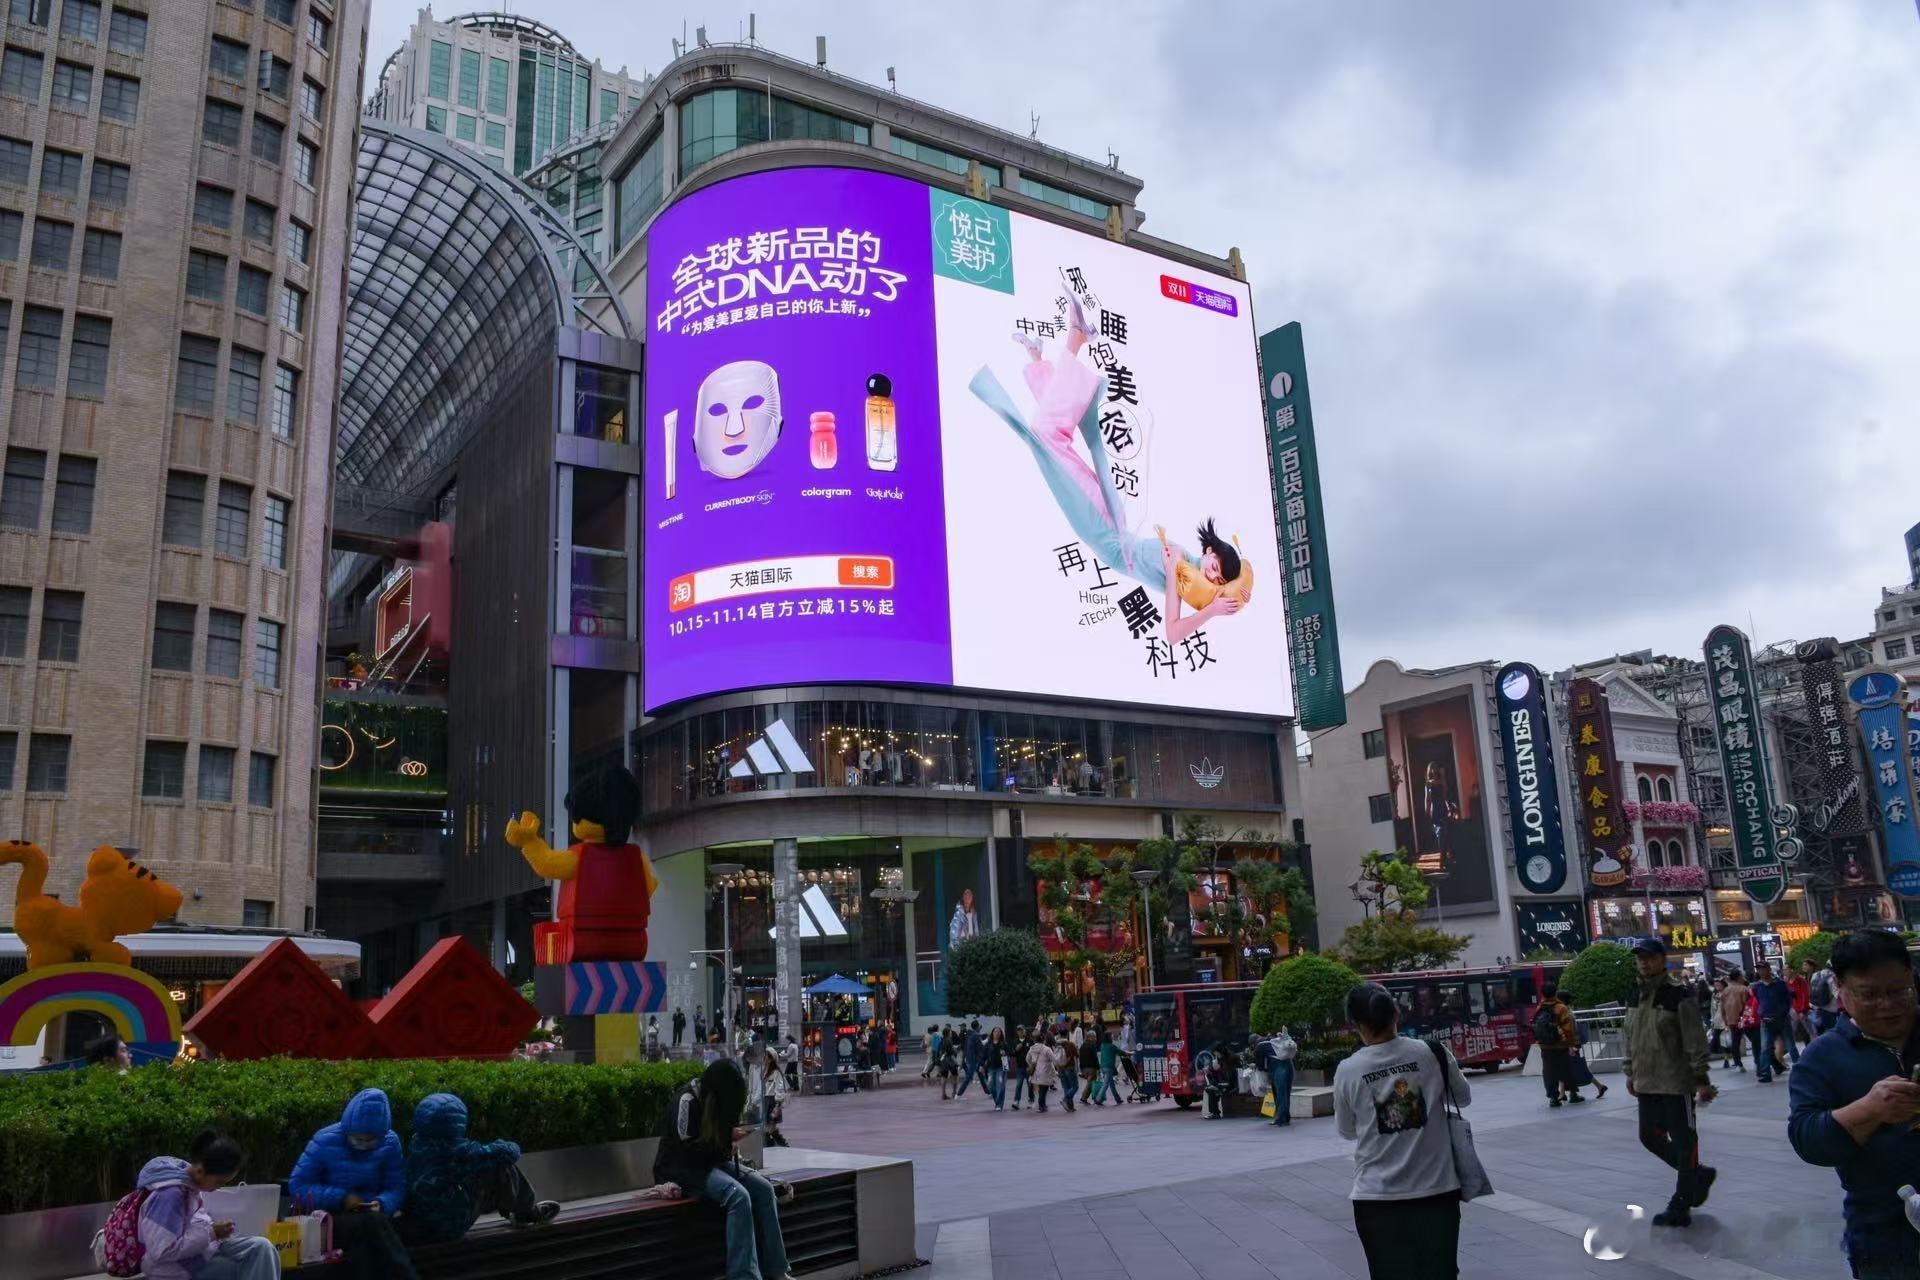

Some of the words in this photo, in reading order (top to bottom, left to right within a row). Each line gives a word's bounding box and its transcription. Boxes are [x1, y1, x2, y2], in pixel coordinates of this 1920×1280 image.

[949, 209, 996, 246] 悦己
[671, 227, 881, 294] 全球新品的
[950, 238, 996, 272] 美护
[656, 262, 908, 334] 中式DNA动了
[1168, 281, 1187, 298] 双11
[1195, 290, 1233, 311] 天猫国际
[704, 495, 757, 512] CURRENTBODY
[801, 486, 852, 499] colorgram
[1275, 404, 1314, 595] 第一百货商业中心
[729, 567, 793, 589] 天猫国际
[852, 564, 880, 579] 搜索
[673, 583, 692, 605] 淘
[1078, 590, 1109, 605] HIGH
[1295, 618, 1307, 666] CENTER
[1311, 613, 1322, 640] NO.1
[1303, 616, 1317, 677] SHOPPING
[1510, 708, 1545, 846] LONGINES
[1579, 722, 1612, 837] 泰康食品
[1731, 754, 1741, 780] SINCE
[1739, 752, 1767, 859] MAOCHANG
[1814, 775, 1860, 831] Duchamp
[1739, 866, 1781, 878] OPTICAL
[1536, 921, 1571, 932] LONGINES
[1362, 1070, 1389, 1084] TEENIE
[1389, 1061, 1420, 1076] WEENIE
